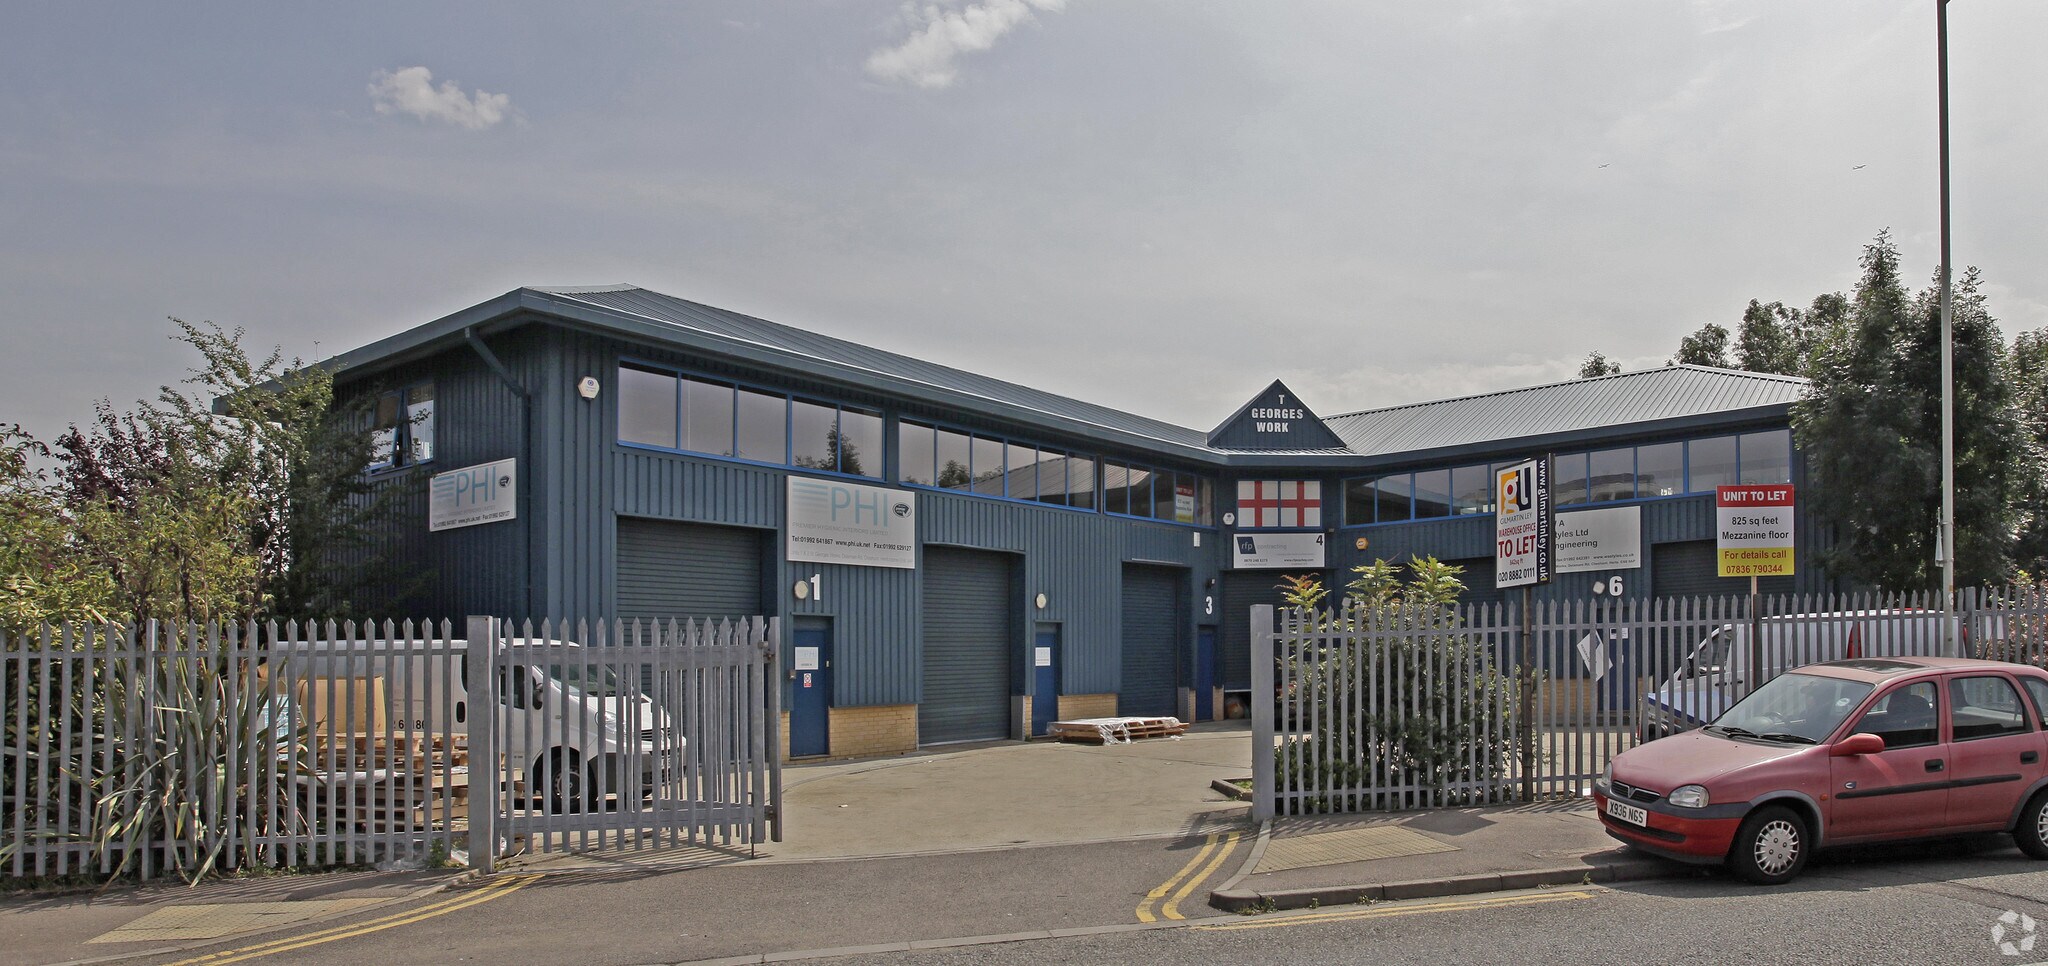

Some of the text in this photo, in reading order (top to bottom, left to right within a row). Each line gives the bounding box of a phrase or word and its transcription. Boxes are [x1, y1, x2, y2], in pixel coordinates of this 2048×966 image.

[1278, 394, 1285, 405] T
[1251, 408, 1304, 419] GEORGES
[1256, 421, 1289, 433] WORK
[456, 466, 497, 507] PHI
[1723, 490, 1787, 502] UNIT TO LET
[831, 486, 889, 528] PHI
[1500, 512, 1532, 525] GILMARTIN LEY
[1537, 459, 1549, 580] www.gilmartinley.co.uk
[1558, 519, 1565, 527] A
[1731, 515, 1779, 527] 825 sq feet
[1498, 522, 1536, 537] WAREHOUSE OFFICE
[1555, 528, 1589, 540] tyles Ltd
[1722, 530, 1789, 540] Mezzanine floor
[1241, 541, 1253, 551] rfp
[1315, 534, 1323, 546] 4
[1555, 539, 1598, 551] ngineering
[1498, 534, 1536, 559] TO LET
[1724, 549, 1787, 560] For details call
[1498, 567, 1535, 582] 020 8882 0111
[1726, 564, 1783, 574] 07836 790344
[810, 573, 820, 601] 1
[1609, 575, 1623, 597] 6
[1205, 595, 1213, 615] 3
[1609, 801, 1644, 824] X936 NGS
